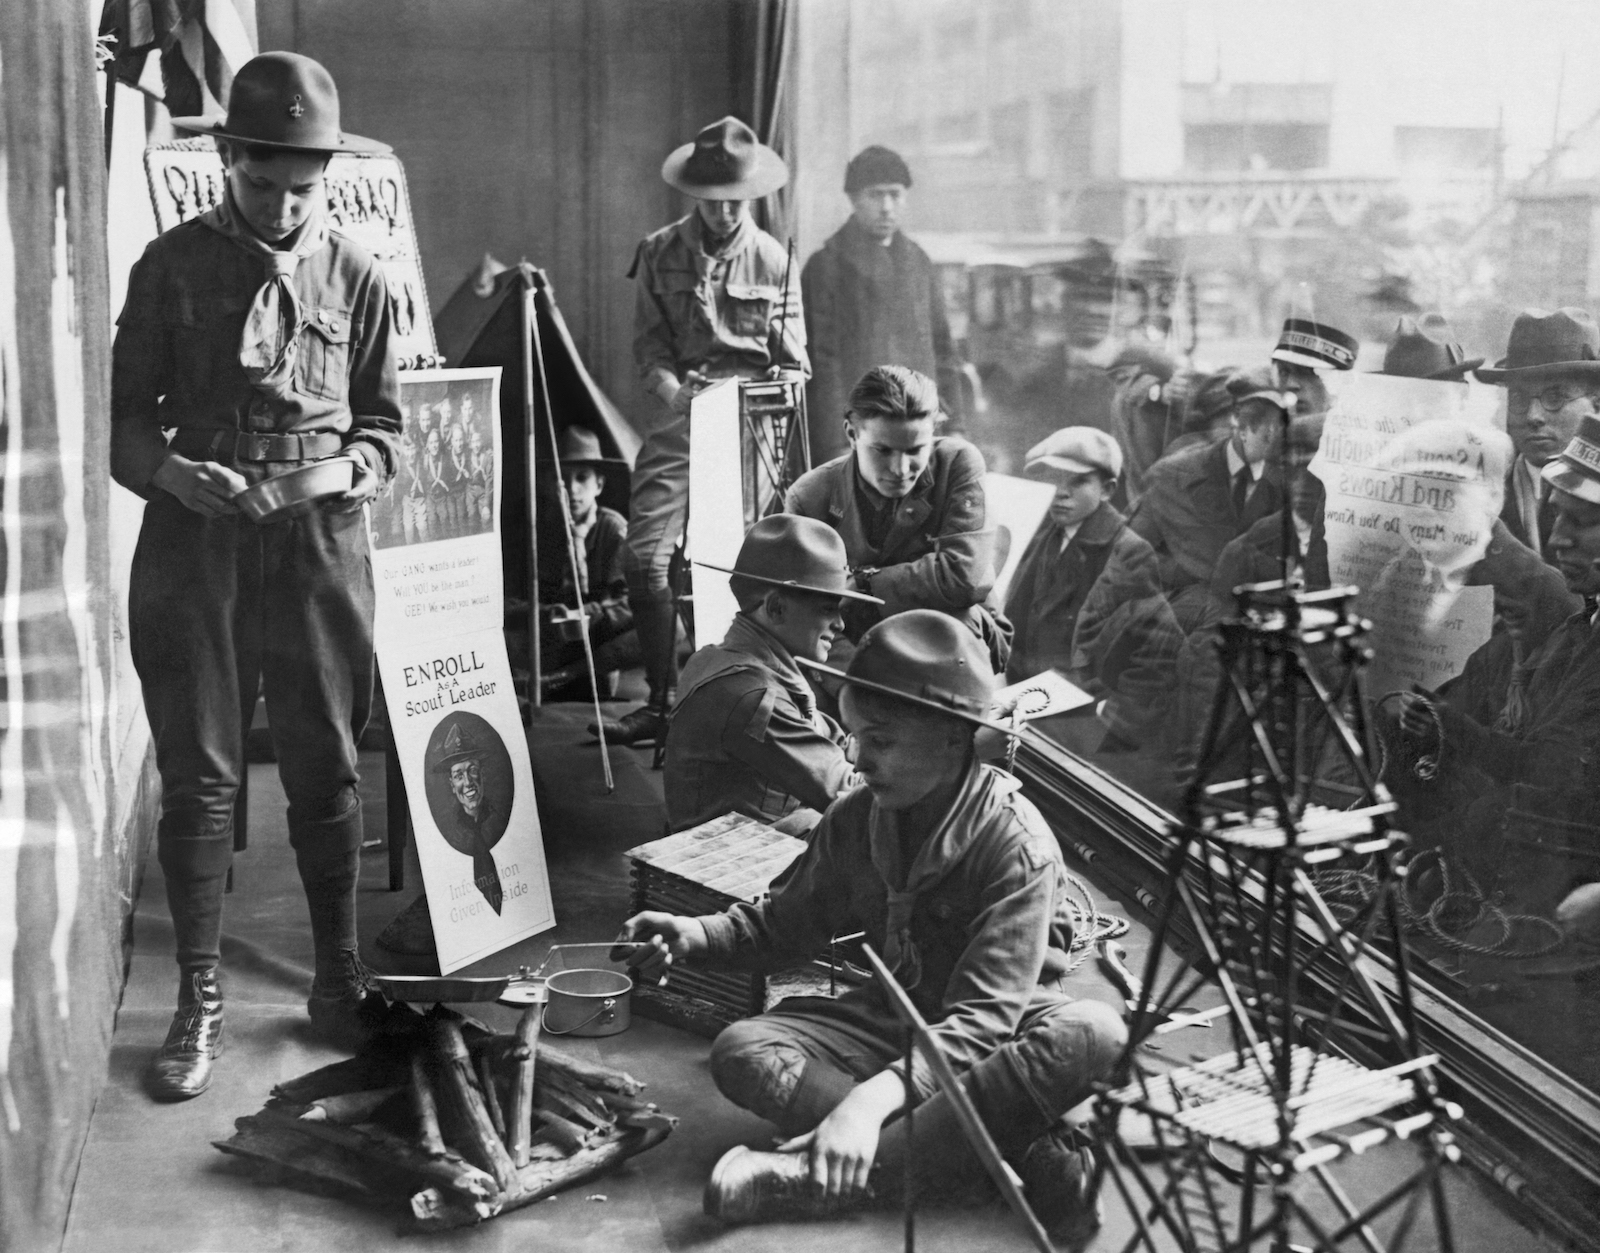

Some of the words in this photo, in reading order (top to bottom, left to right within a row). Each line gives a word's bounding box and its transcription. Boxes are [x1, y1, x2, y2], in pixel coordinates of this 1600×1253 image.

[383, 569, 399, 580] Our
[402, 562, 426, 577] GANG
[428, 560, 450, 572] wants
[451, 561, 456, 569] a
[393, 586, 411, 598] Will
[413, 582, 428, 595] YOU
[431, 583, 439, 593] be
[441, 580, 452, 591] the
[404, 603, 426, 618] GEE!
[428, 601, 438, 613] We
[441, 599, 456, 611] wish
[457, 600, 470, 613] you
[403, 651, 485, 688] ENROLL
[452, 677, 460, 687] A
[405, 693, 445, 717] Scout
[449, 681, 497, 705] Leader
[448, 862, 521, 901] Infomaion
[449, 899, 486, 923] Given
[488, 880, 529, 908] Inside
